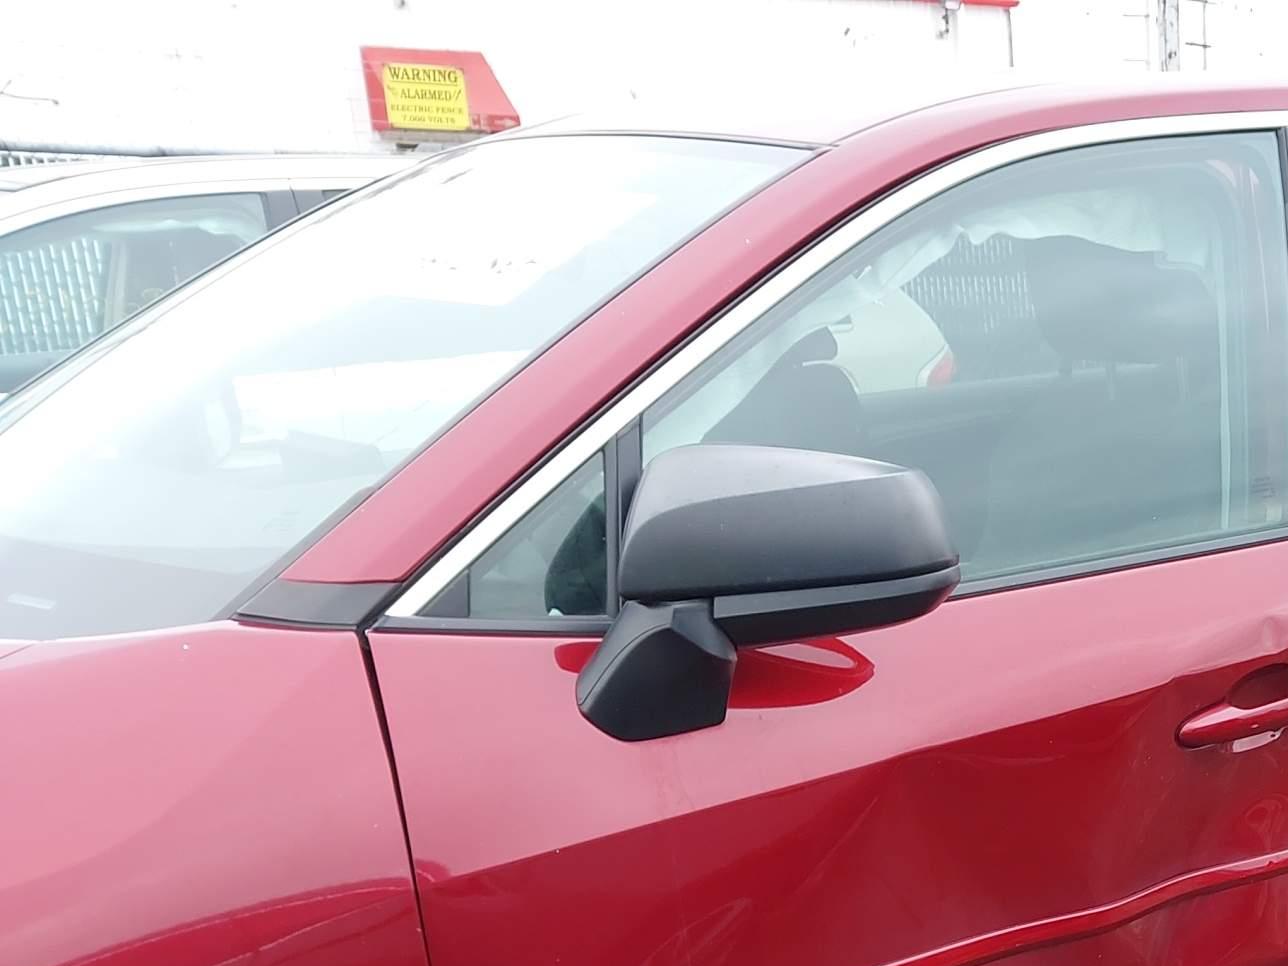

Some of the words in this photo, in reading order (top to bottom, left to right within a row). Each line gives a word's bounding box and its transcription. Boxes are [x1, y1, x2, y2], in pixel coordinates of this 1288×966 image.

[388, 66, 458, 83] WARNING
[400, 87, 452, 101] ALARMED
[390, 104, 434, 113] ELECTRIC
[436, 106, 463, 114] FENCE
[428, 115, 456, 124] VOLTS
